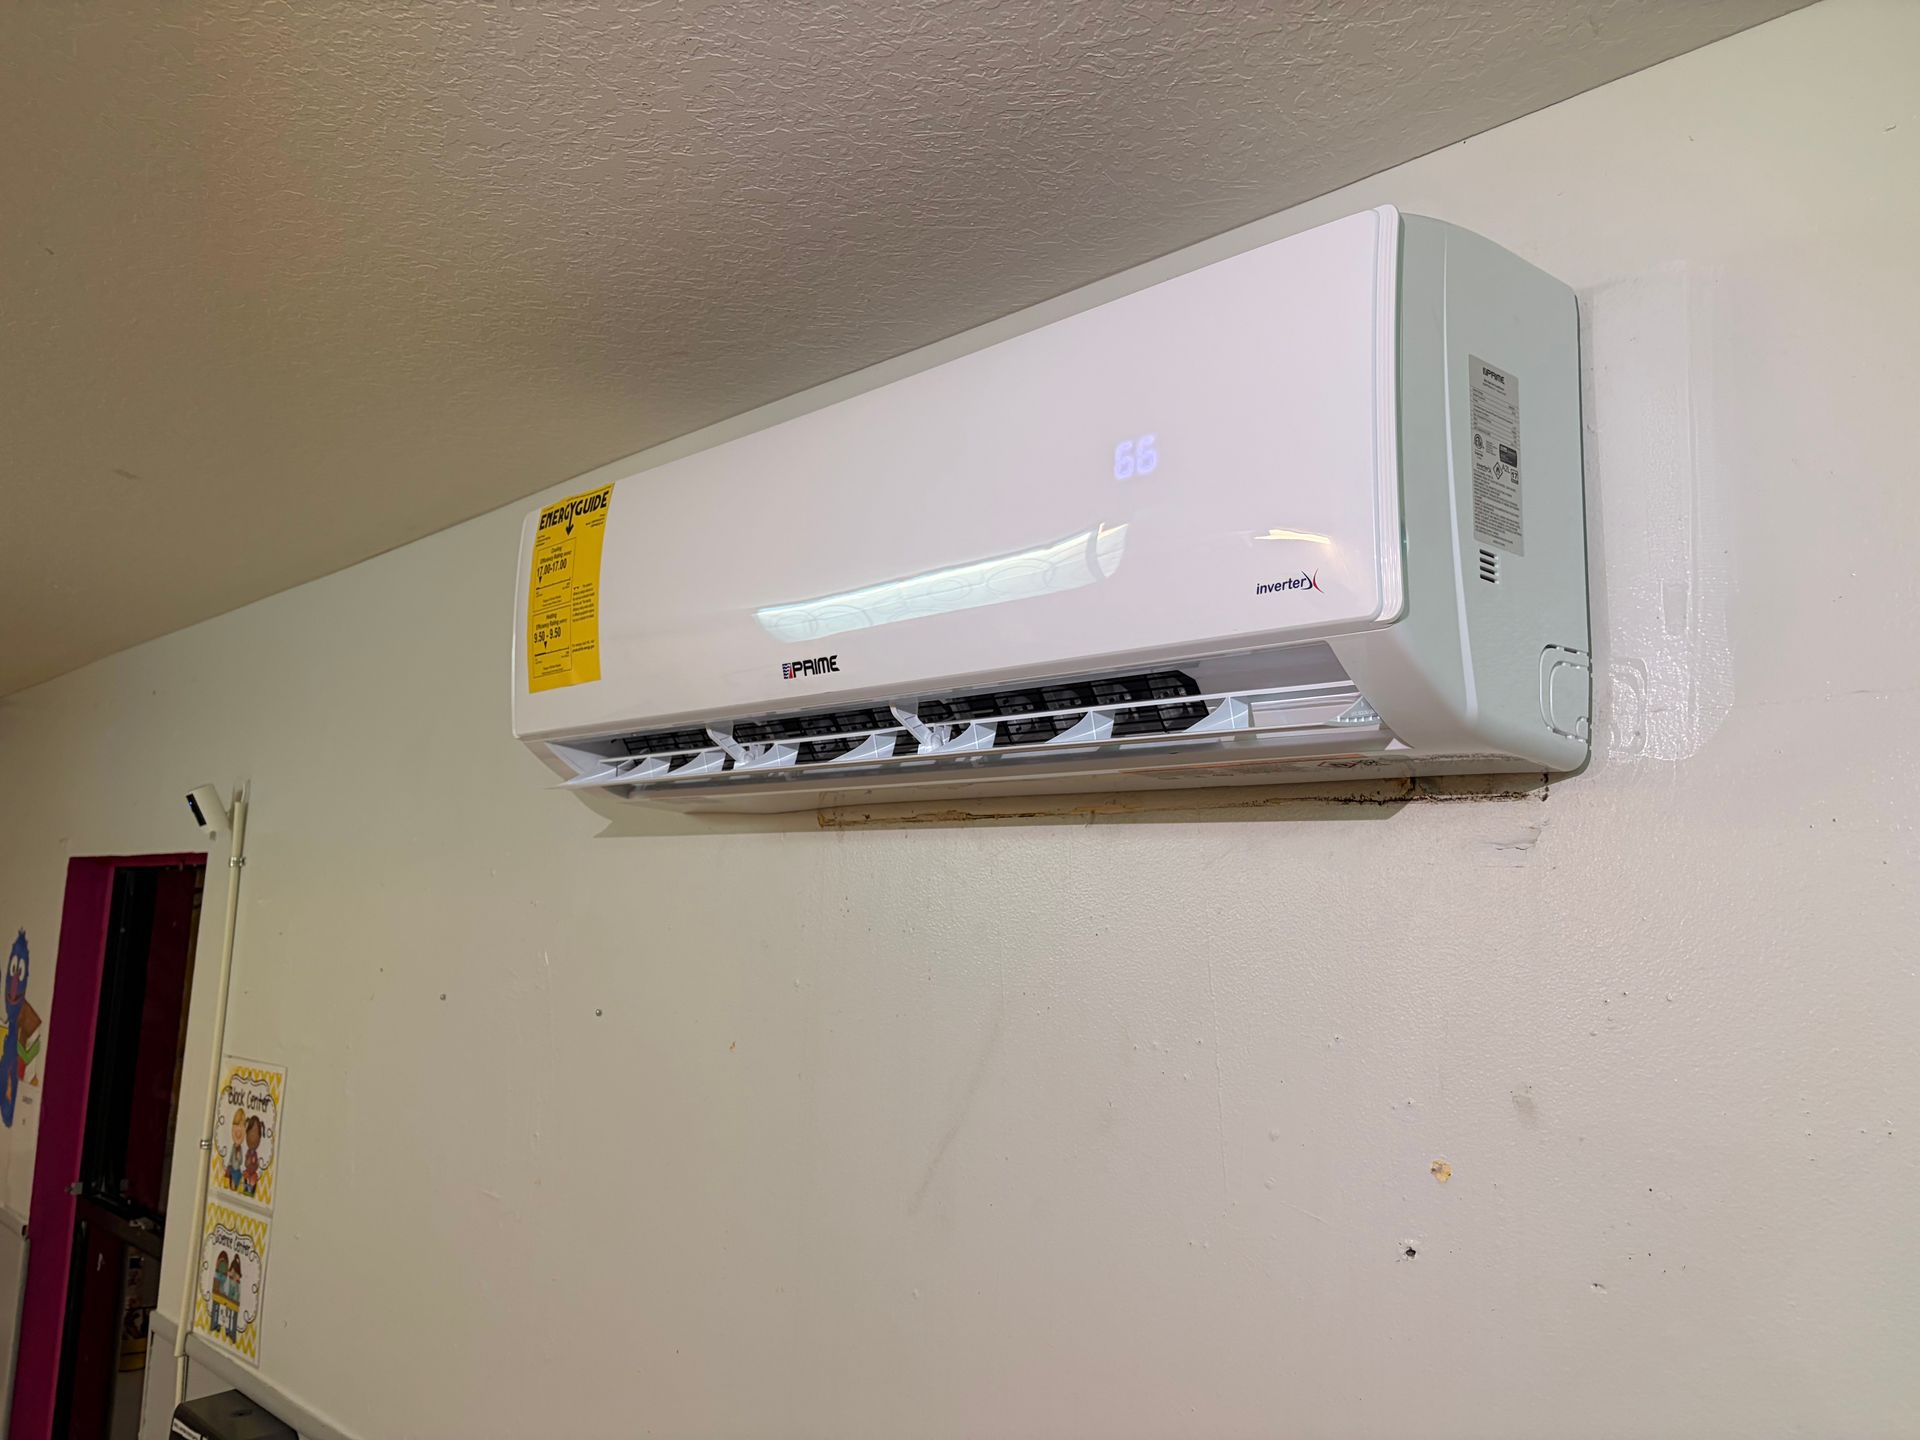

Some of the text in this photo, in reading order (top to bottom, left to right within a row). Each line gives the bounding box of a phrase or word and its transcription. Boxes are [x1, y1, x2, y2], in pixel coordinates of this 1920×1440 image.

[1114, 435, 1157, 480] 66
[539, 490, 610, 531] ENERGYGUIDE
[537, 558, 568, 577] 17.00-17.00
[533, 630, 546, 643] 9.50
[549, 626, 562, 640] 9.50
[791, 655, 841, 678] PRIME
[228, 1086, 271, 1113] Block Center
[233, 1236, 251, 1257] Center
